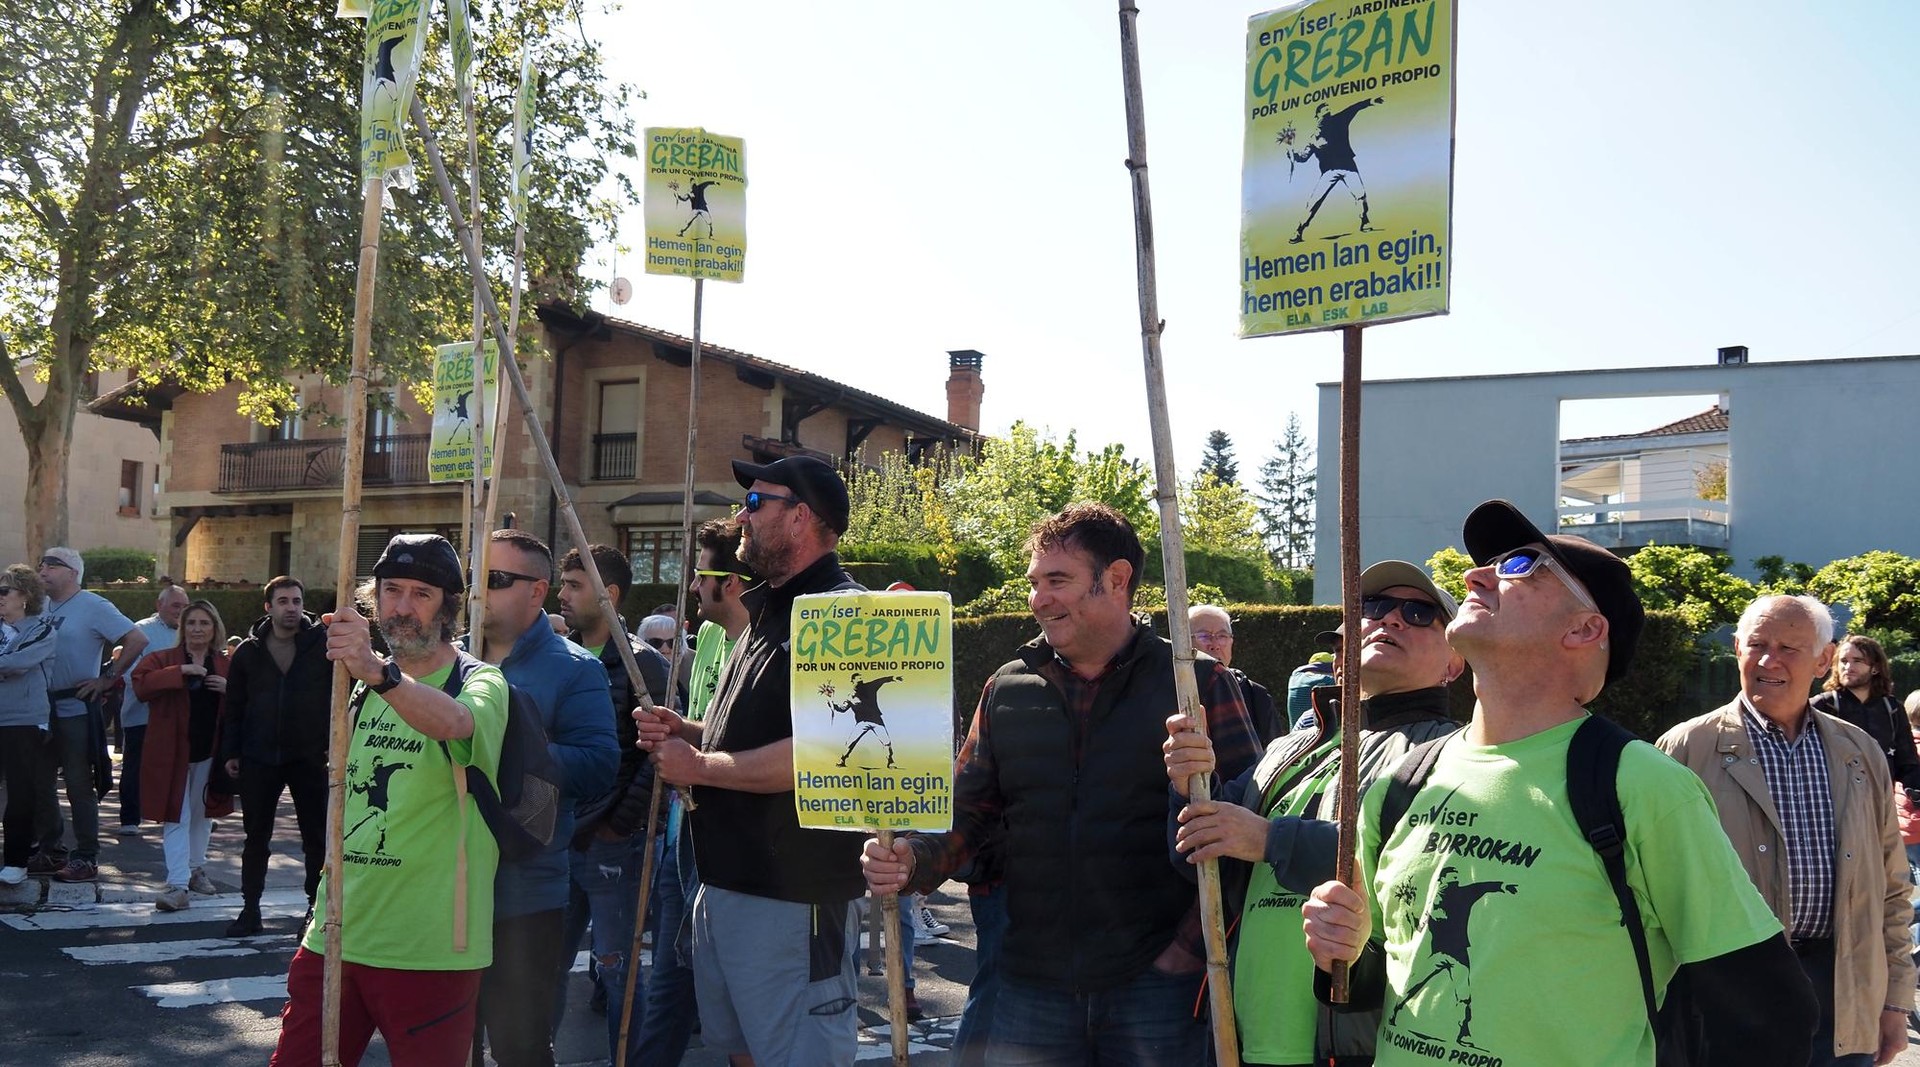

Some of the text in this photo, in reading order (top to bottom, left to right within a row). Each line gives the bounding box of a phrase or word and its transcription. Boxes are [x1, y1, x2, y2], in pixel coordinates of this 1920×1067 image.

[1253, 1, 1435, 104] GREBAN
[1252, 64, 1440, 119] POR UN CONVENIO PROPIO
[651, 143, 738, 173] GREBAN
[682, 168, 718, 178] CONVENIO
[648, 237, 745, 258] Hemen lan egin,
[1244, 229, 1442, 282] Hemen lan egin,
[648, 252, 743, 272] hemen erabaki!!
[1244, 261, 1441, 315] hemen erabaki!!
[1286, 302, 1389, 327] ELA ESK LAB
[437, 355, 494, 386] GREBN
[872, 608, 941, 617] JARDINERIA
[796, 617, 940, 663] GREBAN
[796, 661, 945, 672] POR UN CONVENIO PROPIO
[364, 734, 424, 754] BORROKAN
[797, 771, 949, 795] Hemen lan egin,
[799, 795, 948, 814] hemen erabaki!!
[835, 816, 854, 824] ELA
[889, 818, 911, 826] LAB
[370, 857, 402, 867] PROPIO
[1422, 832, 1541, 868] BORROKAN
[1257, 897, 1298, 909] CONVENIO
[1394, 1034, 1446, 1060] CONVENIO
[1448, 1049, 1503, 1067] PROPIO
